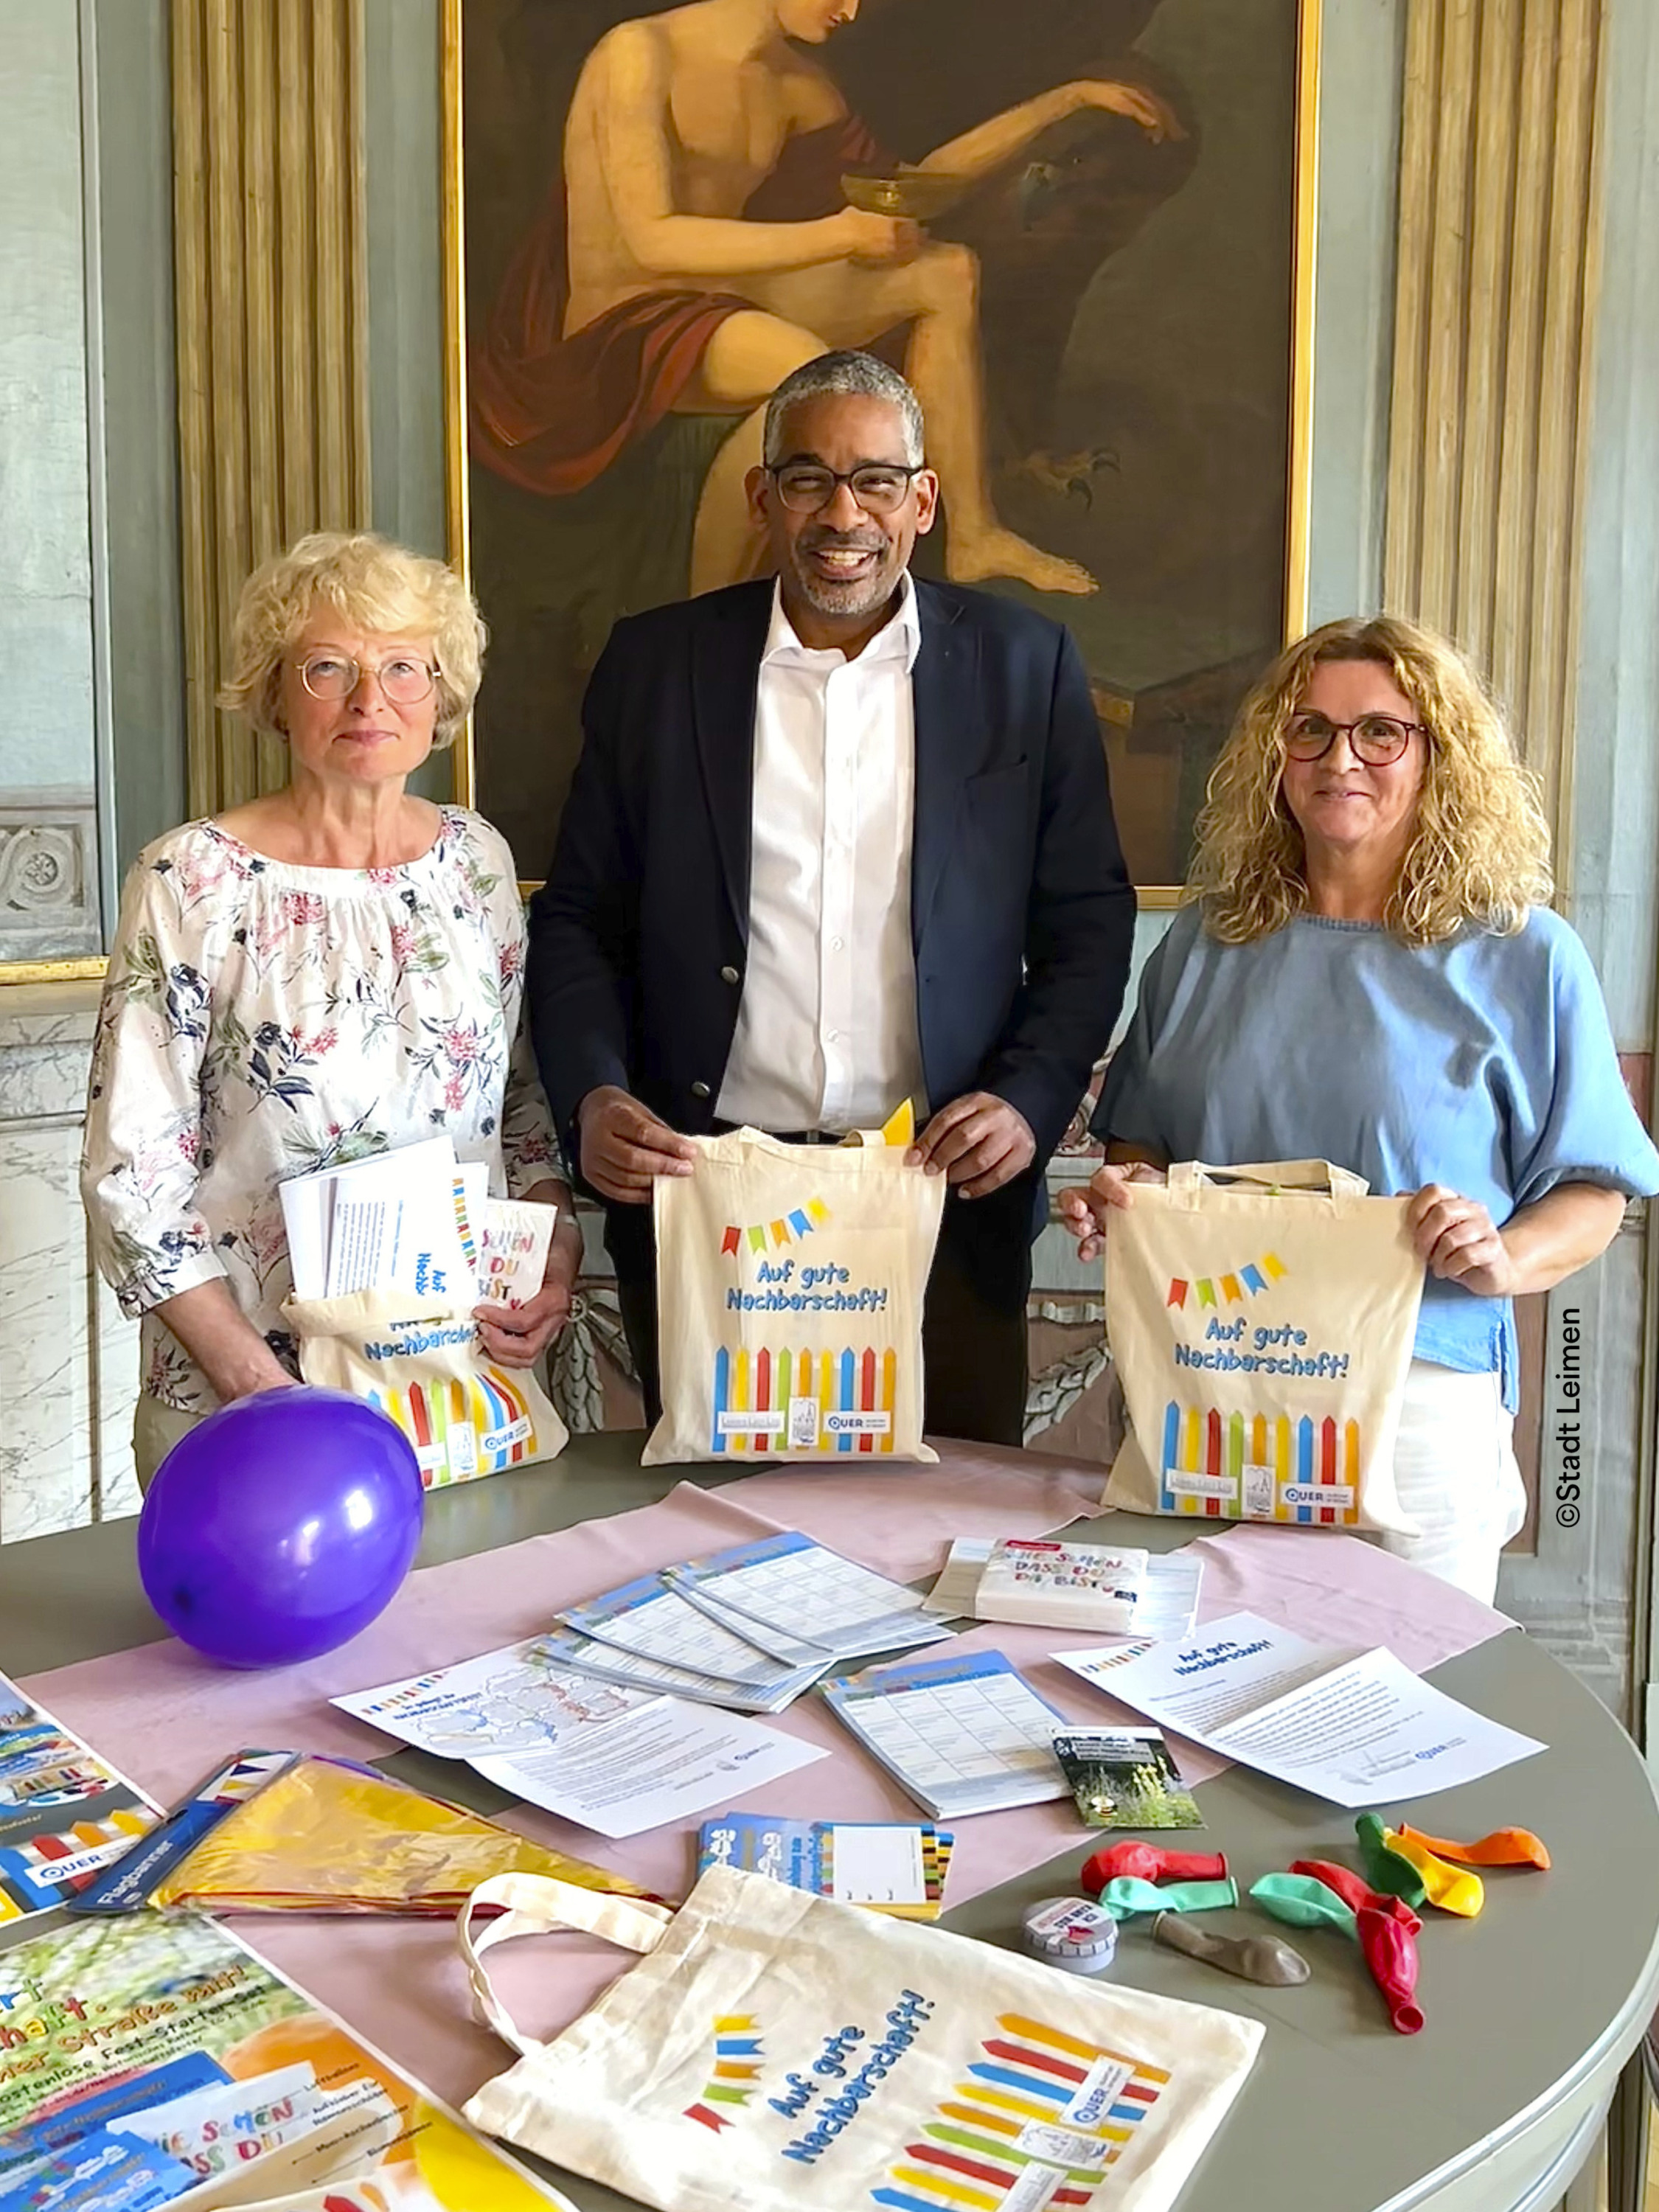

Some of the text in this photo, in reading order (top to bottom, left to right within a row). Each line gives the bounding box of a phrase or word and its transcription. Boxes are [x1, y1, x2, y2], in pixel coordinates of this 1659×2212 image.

[490, 1257, 519, 1276] DU
[757, 1260, 850, 1289] Auf gute
[726, 1287, 888, 1312] Nachbarschaft!
[1206, 1317, 1307, 1349] Auf gute
[1175, 1343, 1349, 1378] Nachbarschaft!
[828, 1416, 863, 1430] QUER
[1285, 1487, 1324, 1502] QUER
[40, 1854, 102, 1879] QUER
[0, 1997, 107, 2050] haft.
[58, 2000, 178, 2052] Straße
[768, 2025, 865, 2118] Auf gute
[781, 1989, 935, 2164] Nachbarschaft!
[1073, 2088, 1107, 2123] QUER
